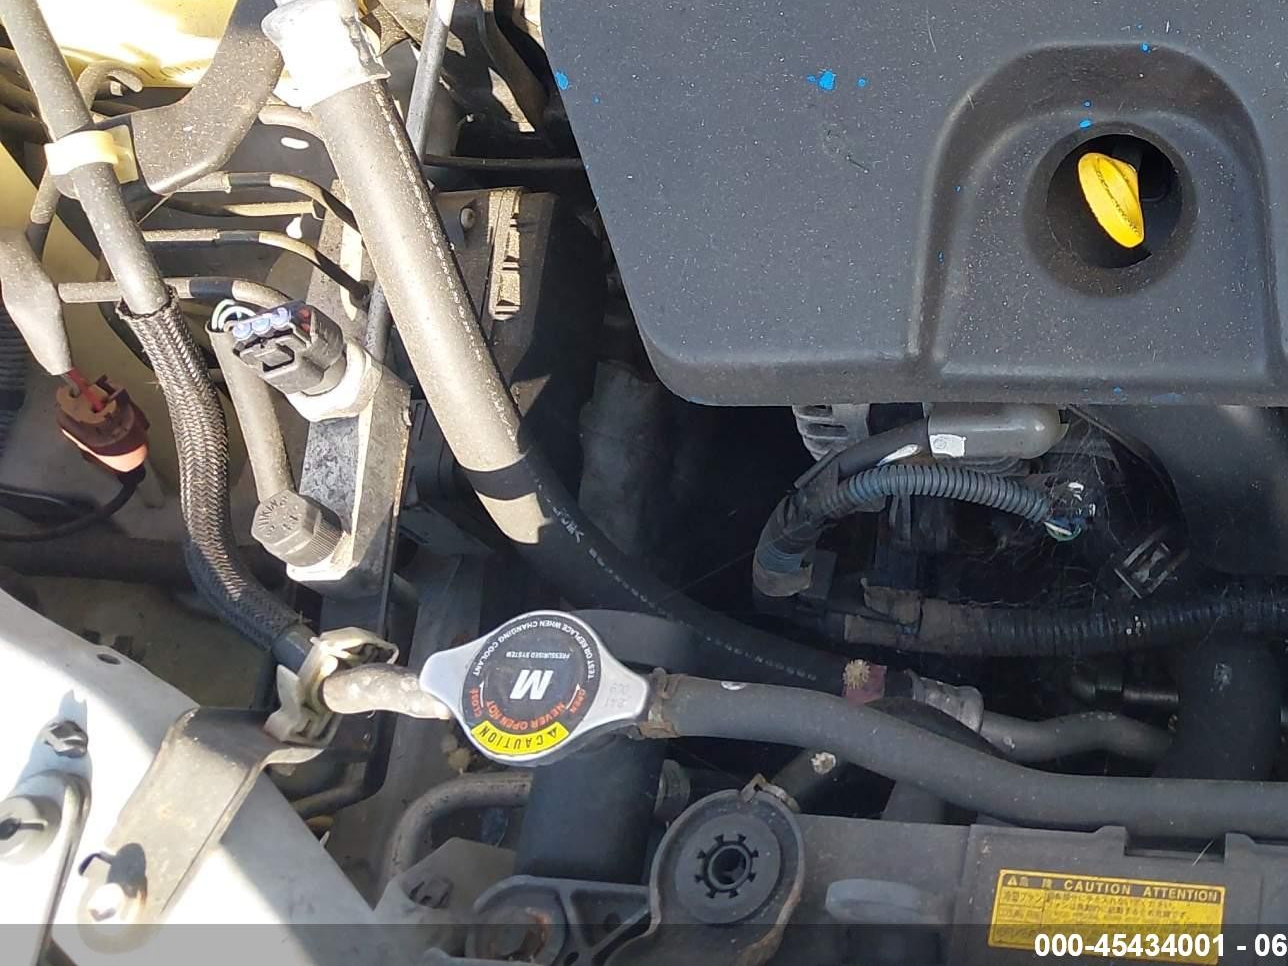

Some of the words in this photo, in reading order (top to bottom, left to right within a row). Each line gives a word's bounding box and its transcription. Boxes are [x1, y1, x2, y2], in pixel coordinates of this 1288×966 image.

[498, 620, 539, 644] CHANGING
[539, 619, 563, 631] WHEN
[561, 624, 588, 651] REPLACE
[472, 641, 499, 677] COOLANT
[582, 647, 593, 659] OR
[587, 659, 595, 681] TEST
[486, 700, 503, 722] HOT
[529, 703, 566, 729] NEVER
[502, 716, 528, 731] OPEN
[479, 725, 545, 751] CAUTION
[1063, 878, 1132, 896] CAUTION
[1143, 885, 1218, 902] ATTENTION
